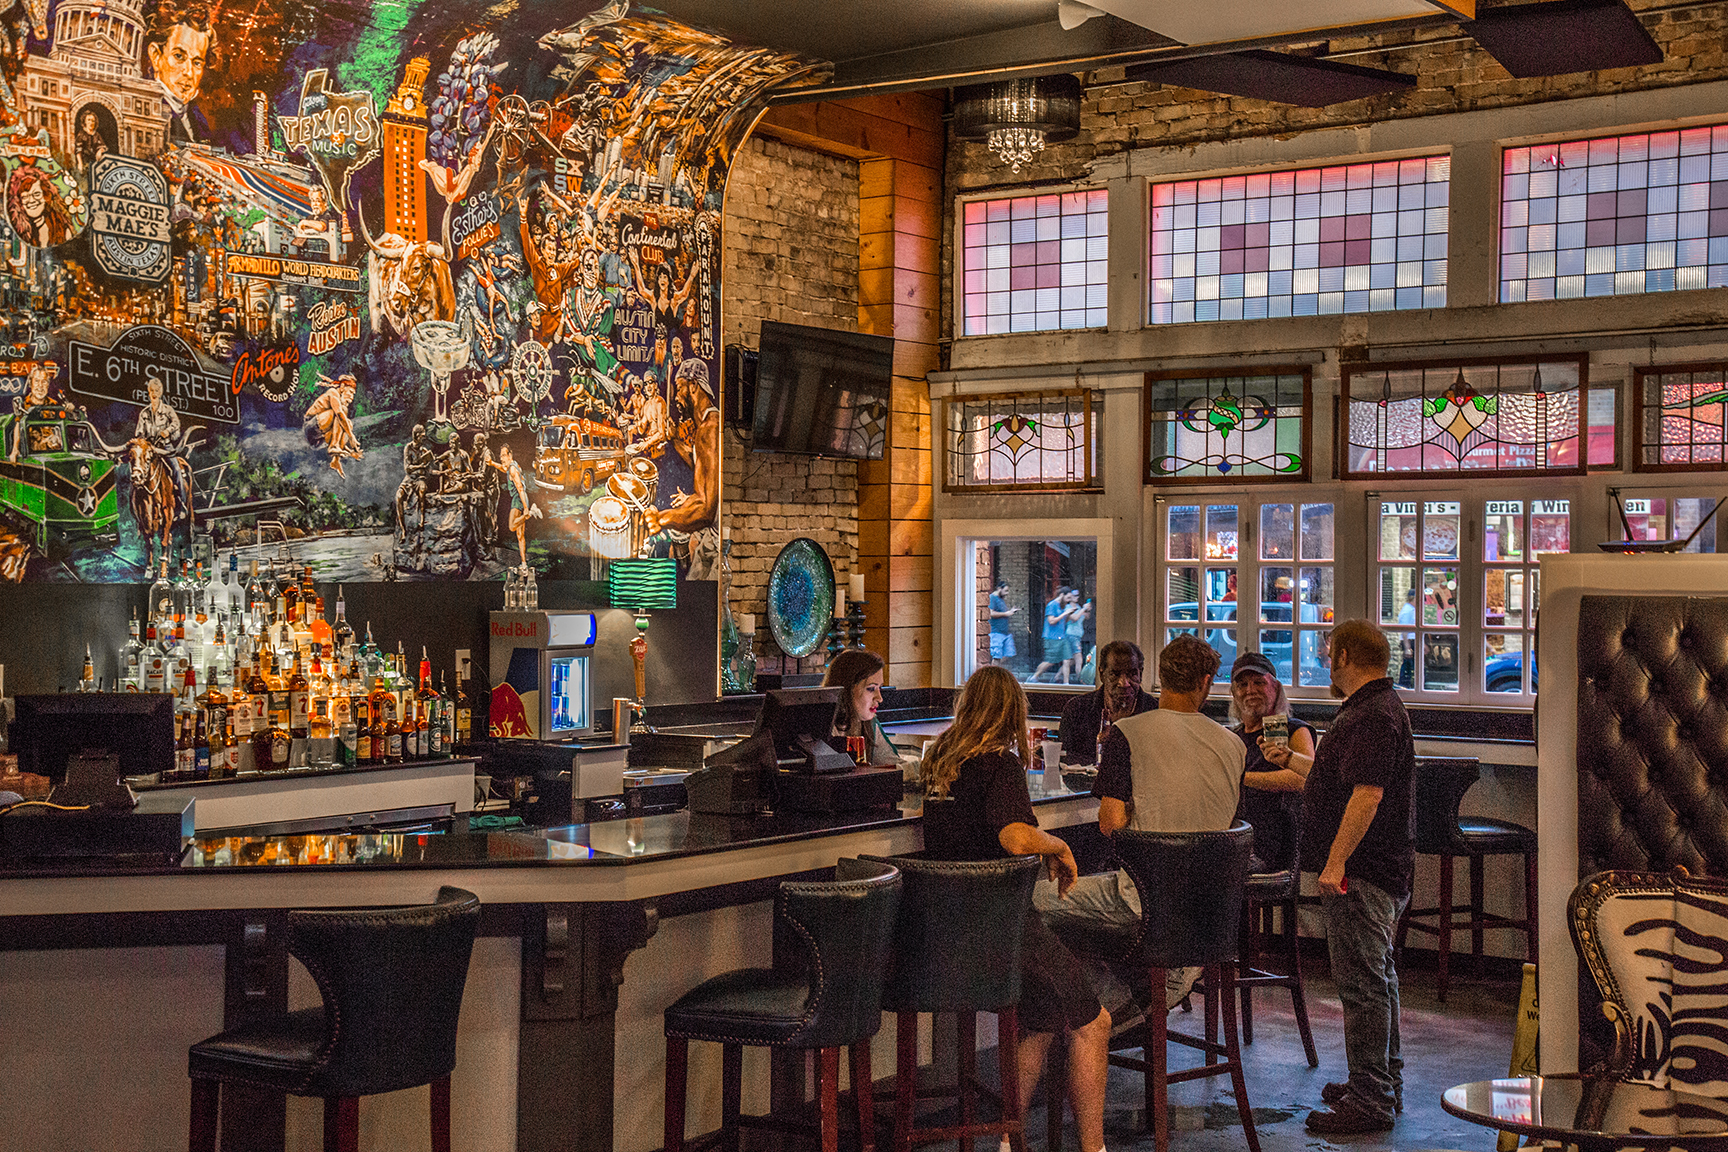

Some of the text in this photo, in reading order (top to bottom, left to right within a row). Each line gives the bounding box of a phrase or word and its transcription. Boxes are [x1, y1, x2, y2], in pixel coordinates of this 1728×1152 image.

[284, 105, 372, 142] TEXAS
[312, 139, 357, 156] MUSIC
[105, 170, 126, 191] SIXTH
[98, 197, 165, 222] MAGGIE
[106, 214, 159, 238] MAE'S
[463, 221, 495, 255] FOLLIES
[622, 223, 678, 249] Continental
[108, 239, 158, 265] AUSTIN TEXAS
[642, 245, 664, 263] CLUB
[227, 255, 360, 281] ARMADILLO WORLD HEADQUARTERS
[701, 231, 711, 354] PARAMOUNT
[307, 299, 347, 332] Rodeo
[613, 308, 656, 329] AUSTIN
[128, 329, 186, 353] SIXTH STREET
[307, 317, 361, 355] AUSTIN
[621, 327, 648, 345] CITY
[120, 344, 195, 367] HISTORIC DISTRICT
[513, 349, 525, 372] AQUA
[523, 342, 548, 361] FESTIVAL
[617, 344, 655, 363] LIMITS
[77, 347, 231, 405] E. 6TH STREET
[232, 341, 300, 395] Antone's
[258, 369, 300, 402] RECORD SHOP
[212, 405, 234, 418] 100
[1508, 445, 1536, 456] Pizza
[491, 622, 537, 637] Red Bull
